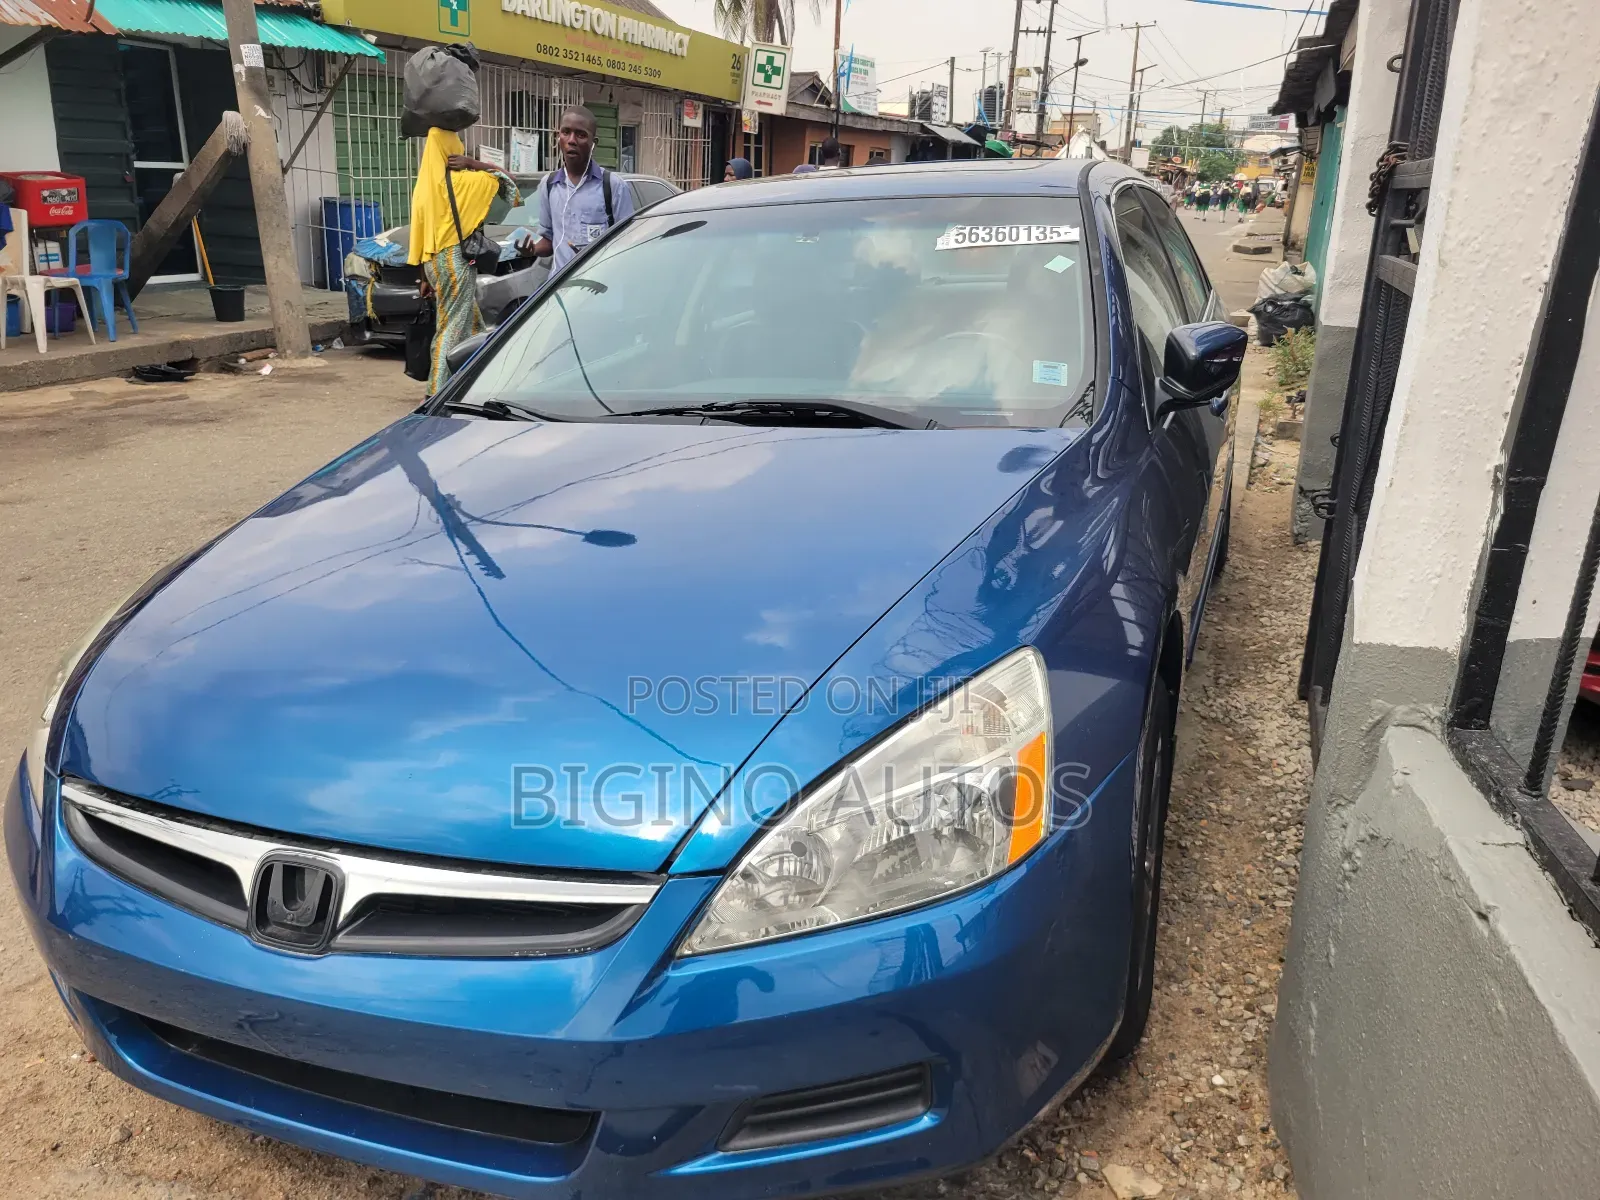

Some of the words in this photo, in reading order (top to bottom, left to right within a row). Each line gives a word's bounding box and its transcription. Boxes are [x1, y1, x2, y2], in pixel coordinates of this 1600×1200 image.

[618, 15, 690, 57] PHARMACY
[536, 43, 560, 57] 0802
[606, 58, 626, 71] 0803
[628, 64, 642, 75] 245
[644, 66, 662, 79] 5309
[731, 53, 742, 71] 26
[49, 206, 74, 216] Coca-Cola
